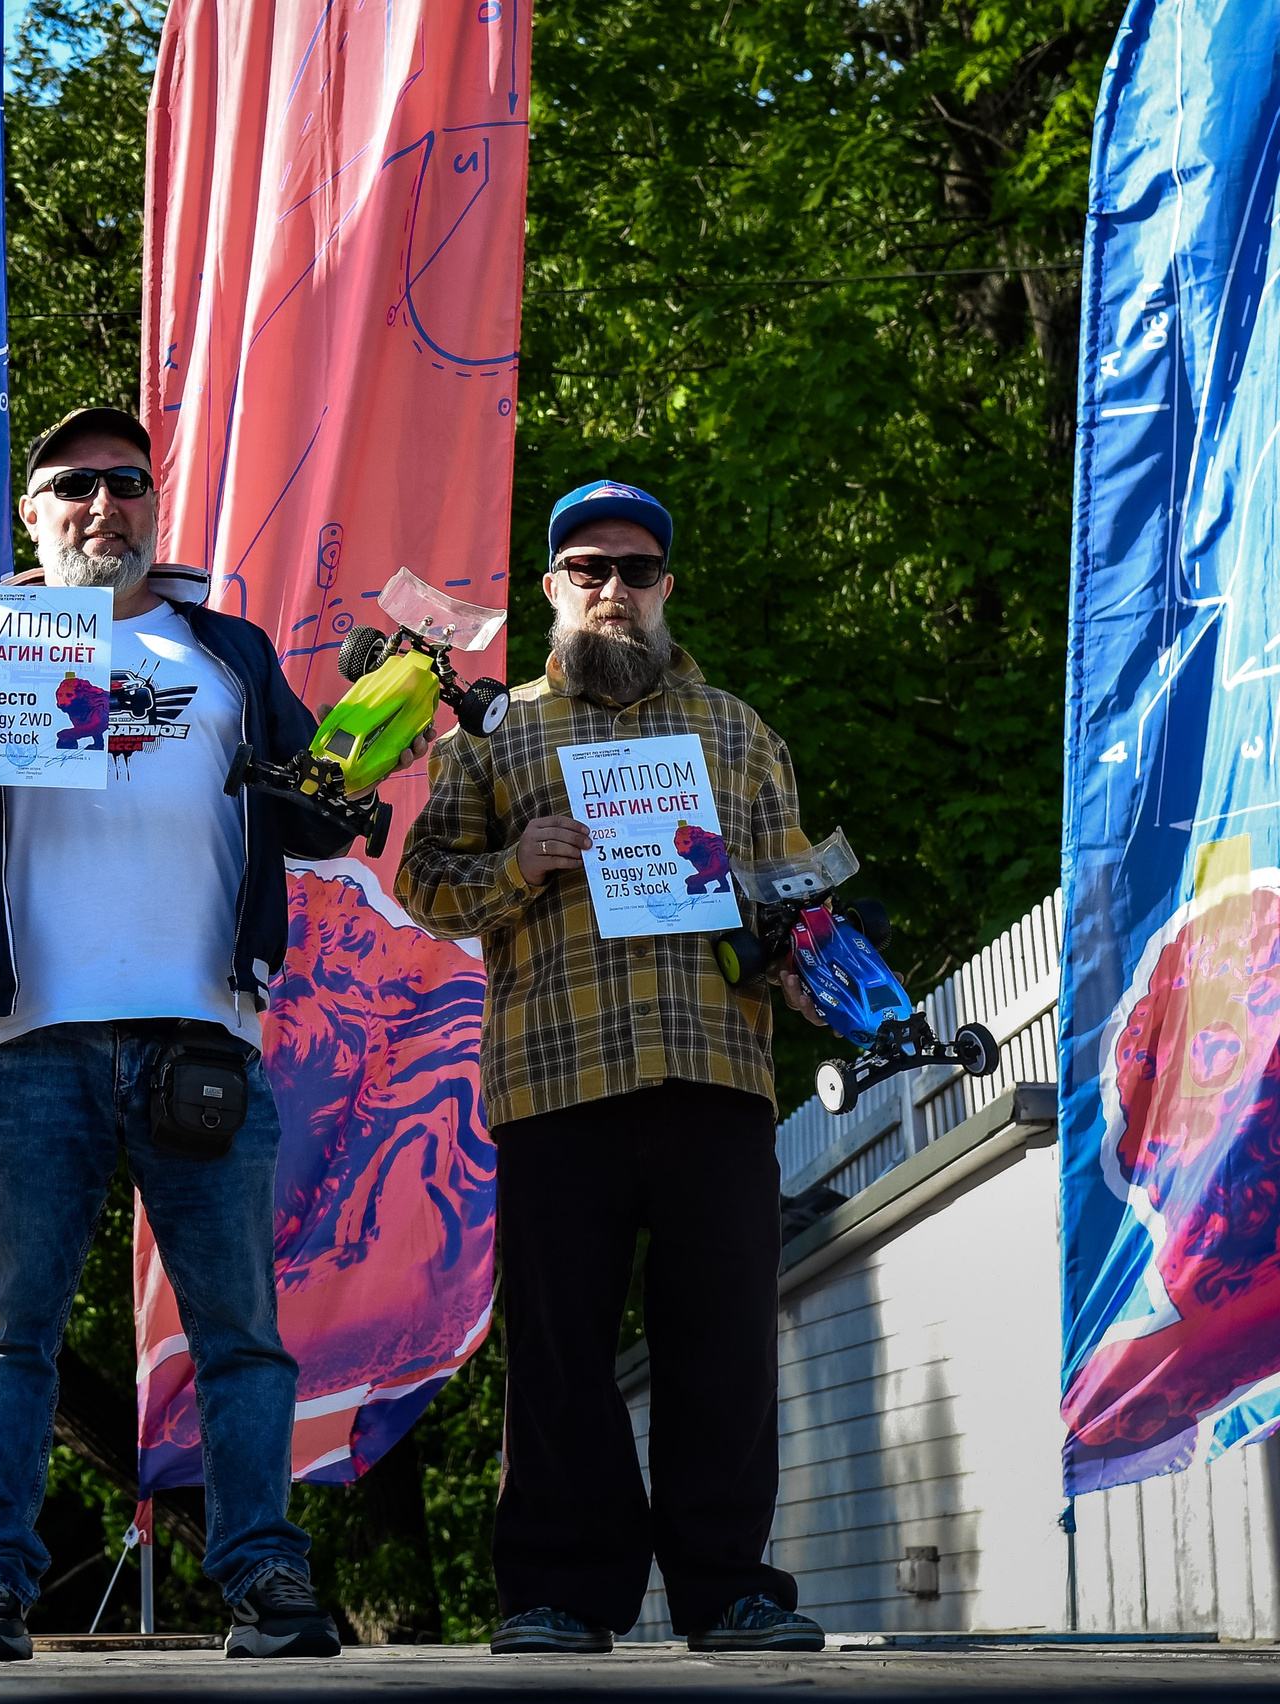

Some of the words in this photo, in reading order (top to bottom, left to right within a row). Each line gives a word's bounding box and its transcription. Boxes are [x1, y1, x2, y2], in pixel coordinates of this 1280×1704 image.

[49, 643, 95, 663] СЛЁТ
[20, 713, 51, 726] 2WD
[0, 730, 39, 744] stock
[582, 761, 696, 799] ДИПЛОМ
[586, 798, 651, 819] ЕЛАГИН
[658, 791, 699, 812] СЛЁТ
[592, 829, 617, 840] 2025
[596, 846, 606, 861] 3
[612, 843, 661, 860] место
[602, 867, 643, 882] Buggy
[648, 862, 677, 876] 2WD
[605, 884, 629, 898] 27.5
[634, 880, 670, 896] stock
